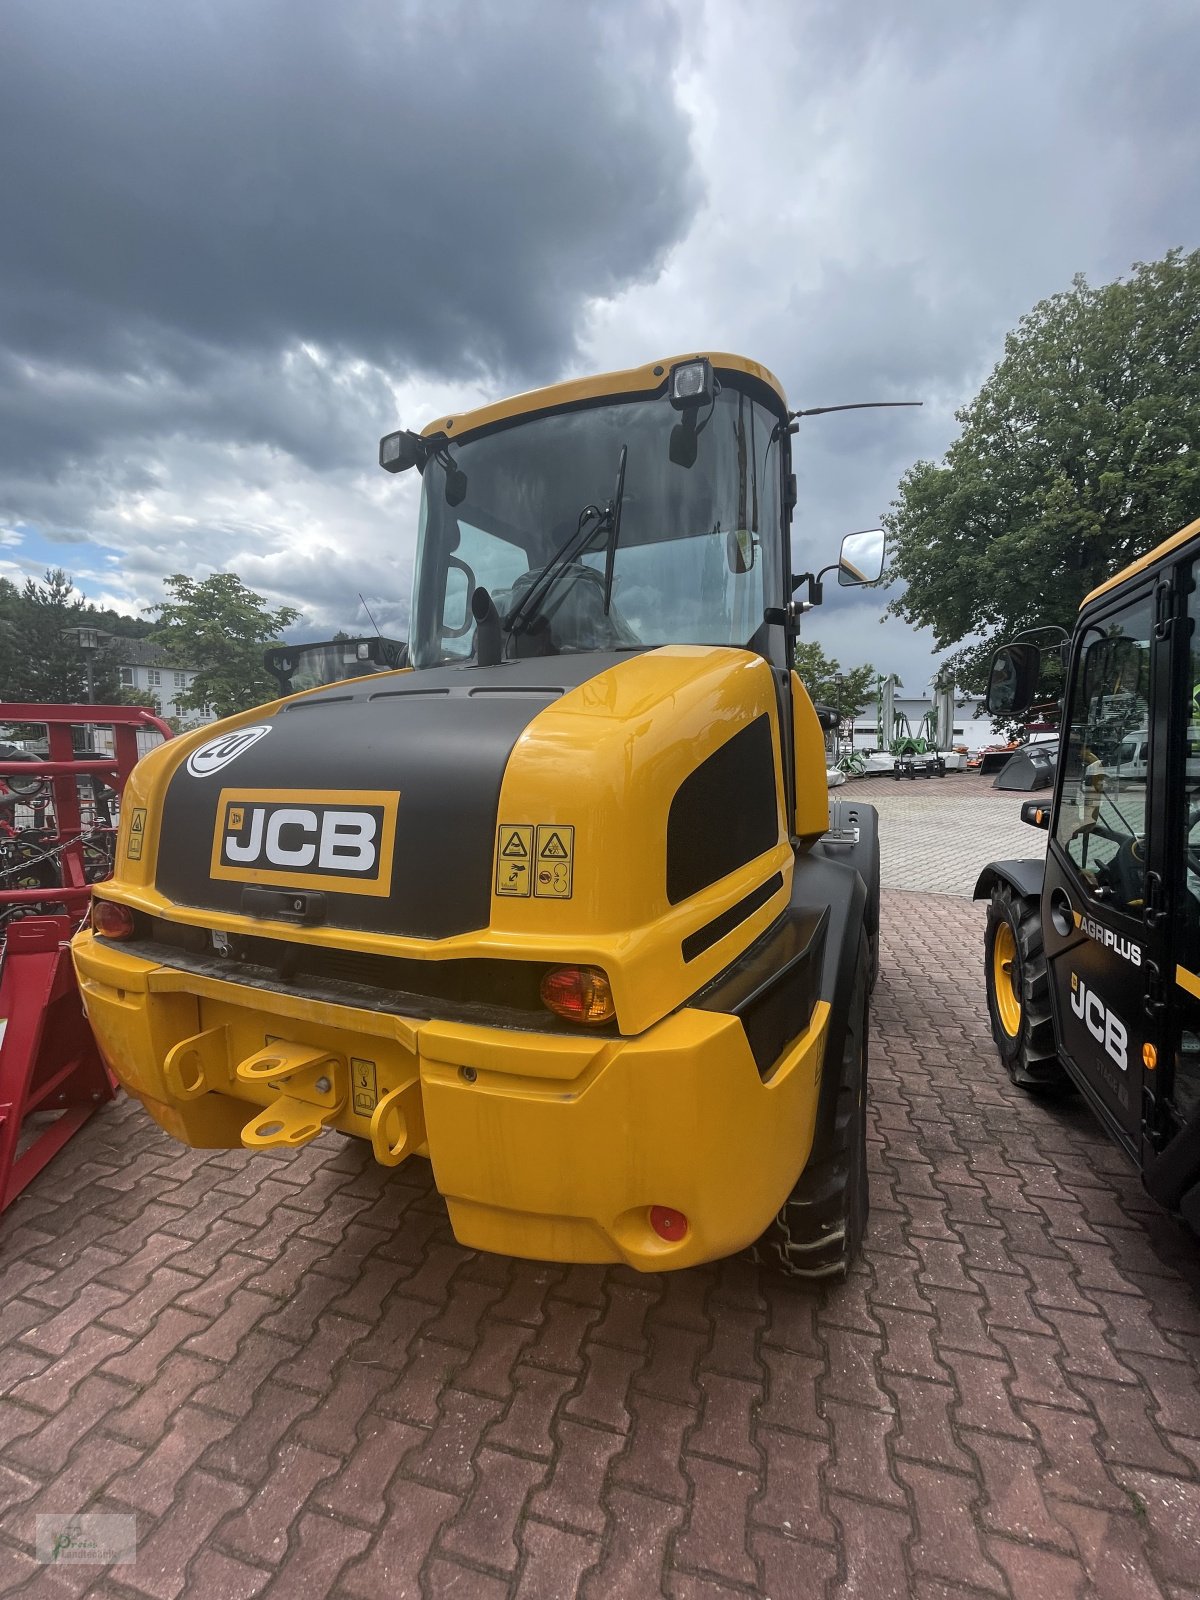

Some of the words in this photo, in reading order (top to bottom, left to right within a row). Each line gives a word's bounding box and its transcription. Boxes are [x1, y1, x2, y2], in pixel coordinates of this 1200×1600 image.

[197, 734, 257, 759] 20
[225, 808, 377, 871] JCB
[1070, 980, 1128, 1071] JCB
